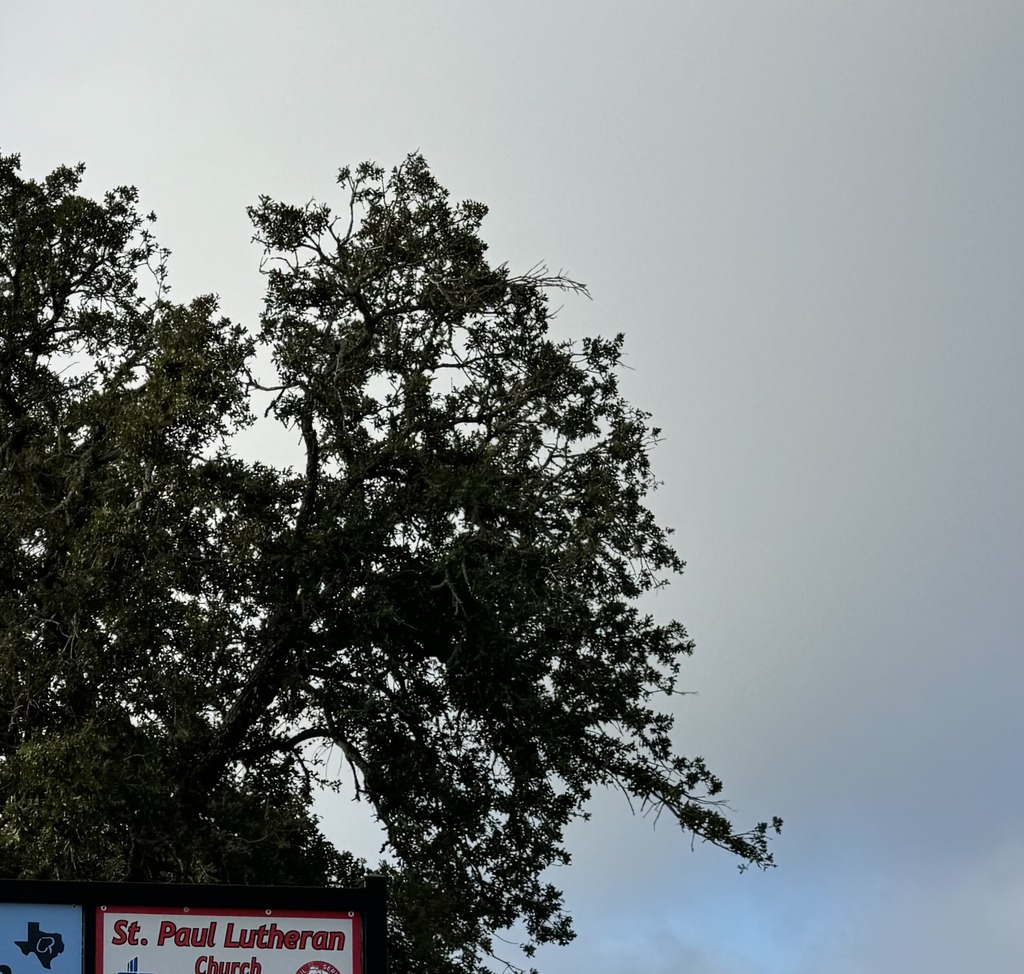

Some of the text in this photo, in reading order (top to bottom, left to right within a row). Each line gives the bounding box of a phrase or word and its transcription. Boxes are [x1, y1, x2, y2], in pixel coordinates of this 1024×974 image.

[111, 919, 346, 950] St. Paul Lutheran
